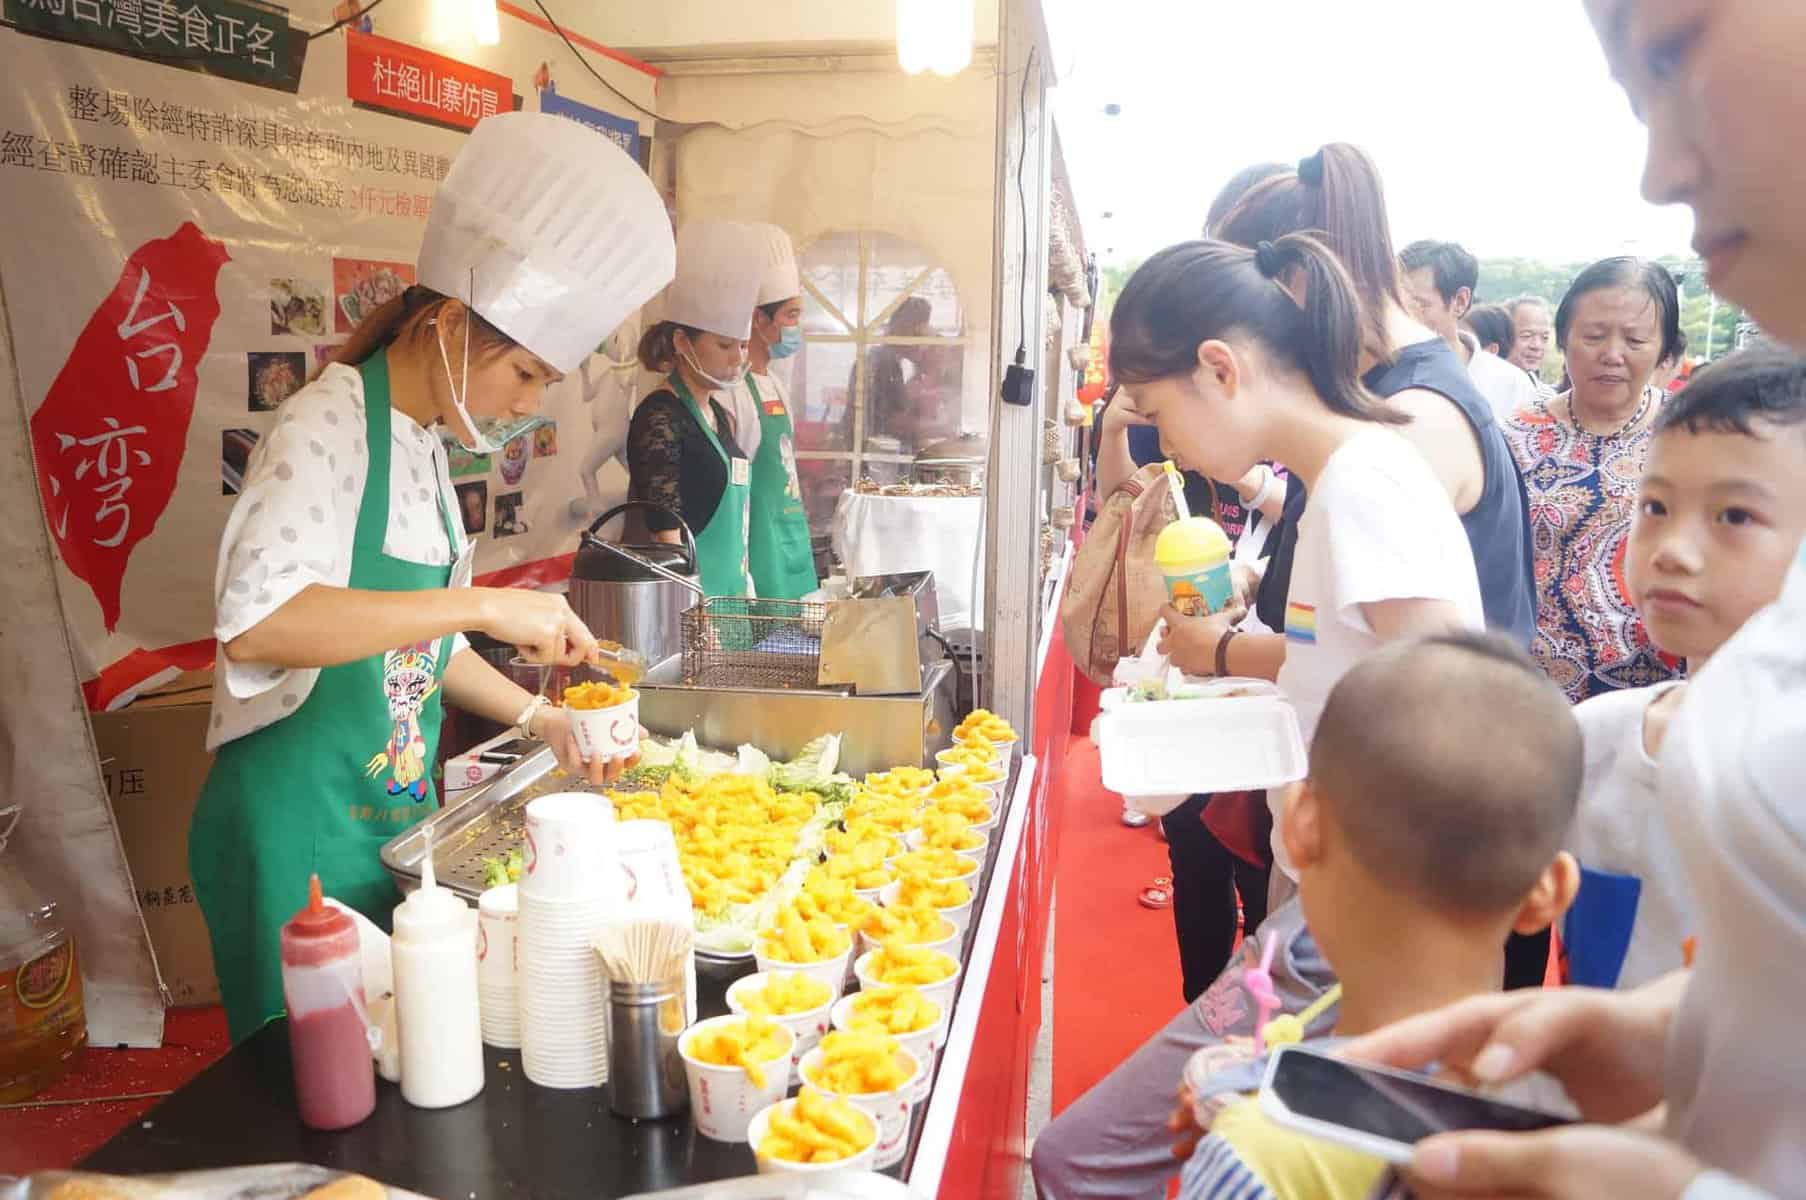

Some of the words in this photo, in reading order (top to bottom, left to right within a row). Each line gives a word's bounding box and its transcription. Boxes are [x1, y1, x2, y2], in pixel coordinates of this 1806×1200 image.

[373, 55, 498, 119] 杜絕山寨仿冒
